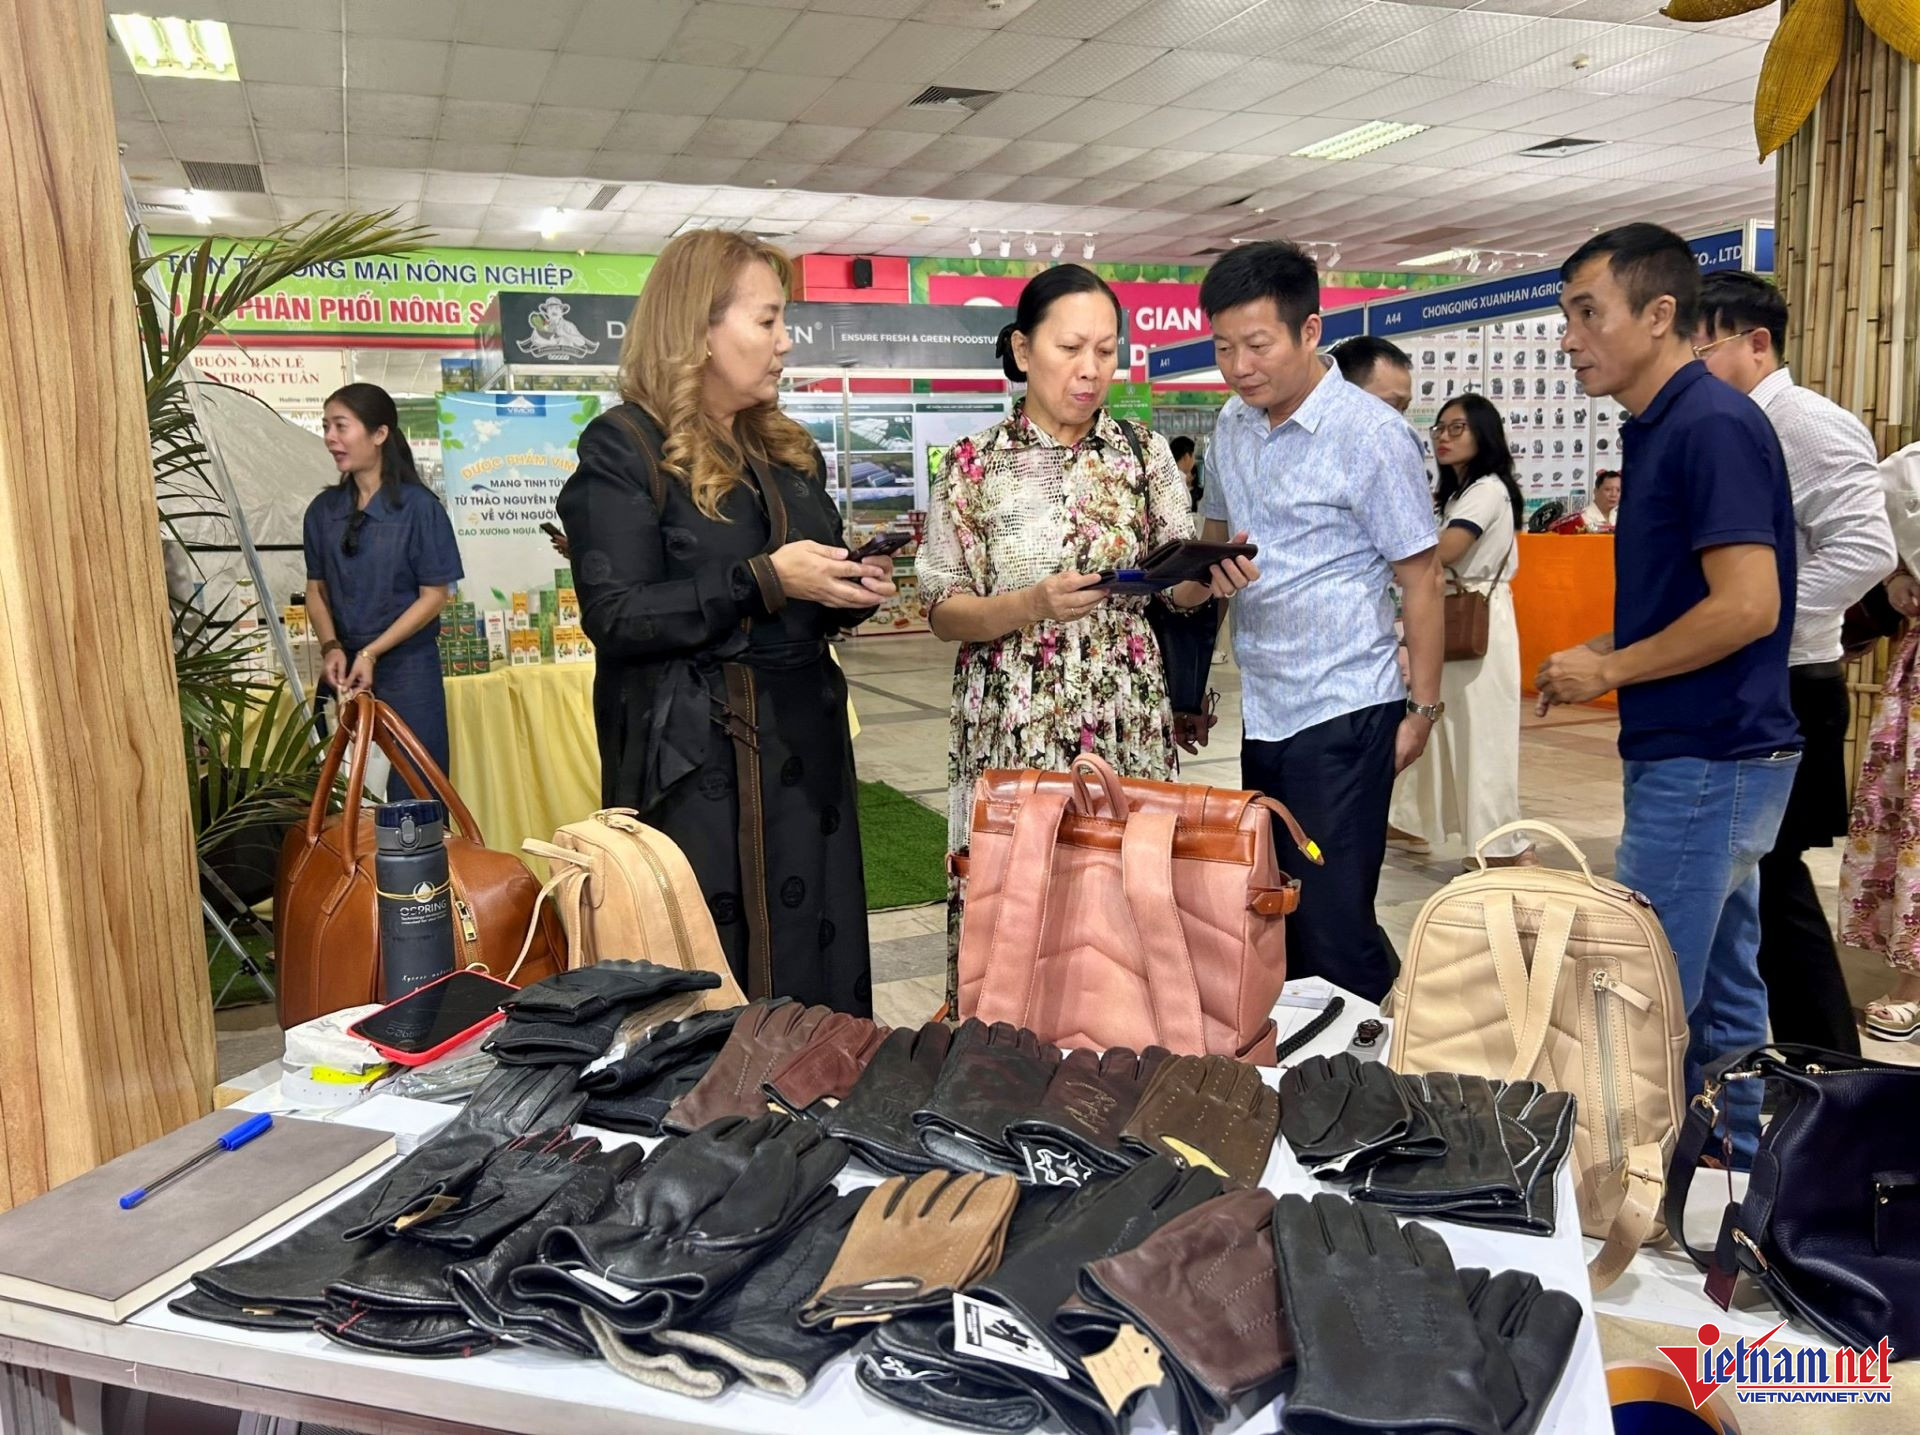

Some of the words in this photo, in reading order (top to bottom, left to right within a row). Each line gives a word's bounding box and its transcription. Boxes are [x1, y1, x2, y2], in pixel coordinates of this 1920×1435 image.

[1719, 245, 1743, 263] LTD
[355, 261, 398, 285] MẠI
[407, 260, 477, 284] NÔNG
[485, 263, 573, 290] NGHIỆP
[320, 291, 382, 323] PHỐI
[389, 295, 462, 324] NÔNG
[1384, 312, 1401, 326] A44
[1422, 297, 1479, 319] CHONGQING
[1480, 287, 1529, 308] XUANHAN
[1530, 281, 1564, 299] AGRIC
[1135, 306, 1202, 332] GIAN
[841, 333, 879, 342] ENSURE
[880, 333, 910, 343] FRESH
[912, 335, 918, 343] &
[920, 335, 951, 344] GREEN
[194, 353, 238, 367] BUÔN
[551, 455, 577, 473] VIM
[490, 479, 522, 488] MANG
[524, 479, 547, 488] TINH
[470, 493, 501, 506] THẢO
[503, 493, 547, 506] NGUYÊN
[498, 509, 518, 521] VỚI
[457, 528, 477, 537] CAO
[399, 899, 447, 917] OSPRING
